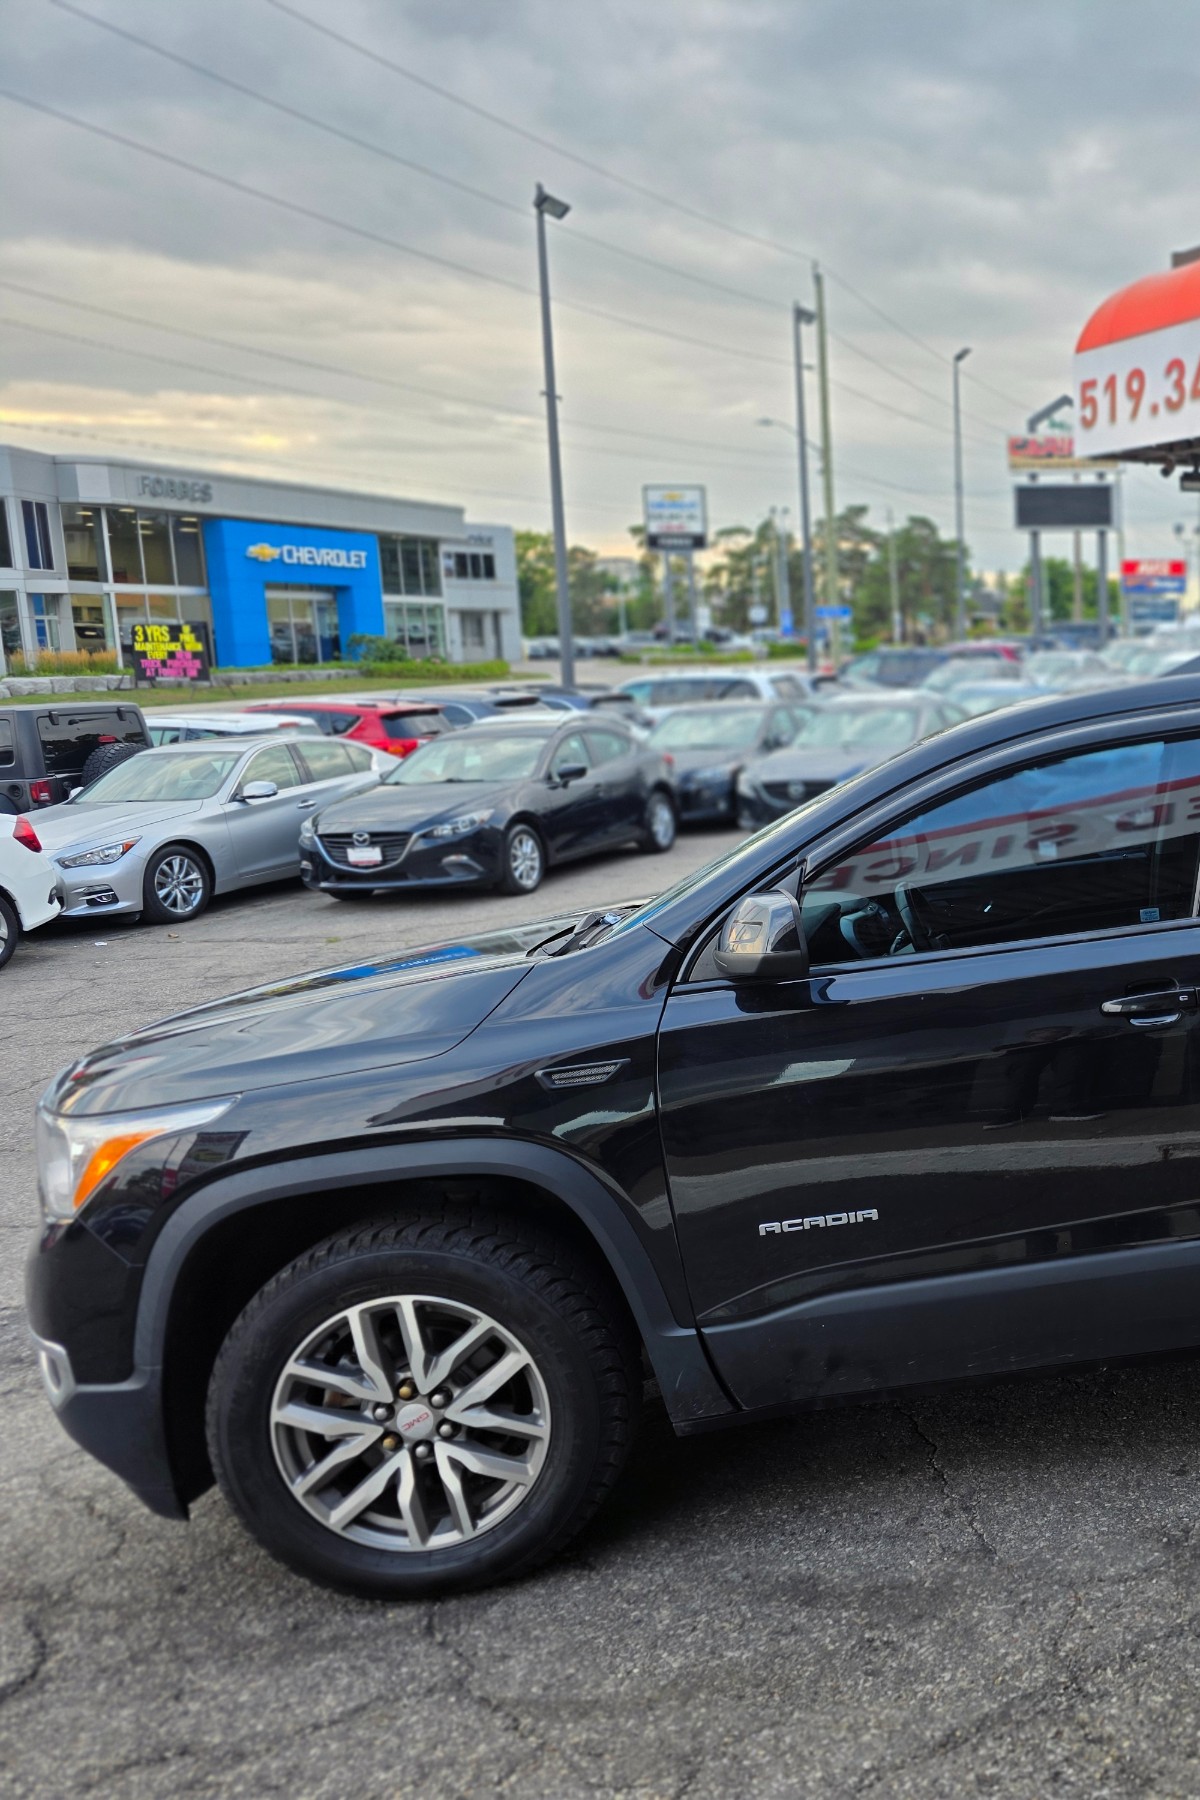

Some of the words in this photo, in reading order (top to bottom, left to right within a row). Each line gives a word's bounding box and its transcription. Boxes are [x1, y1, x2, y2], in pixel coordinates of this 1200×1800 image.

[281, 544, 367, 569] CHEVROLET
[134, 624, 144, 642] 3
[145, 624, 170, 642] YRS
[759, 1209, 879, 1236] ACADIA
[401, 1412, 430, 1432] GMC
